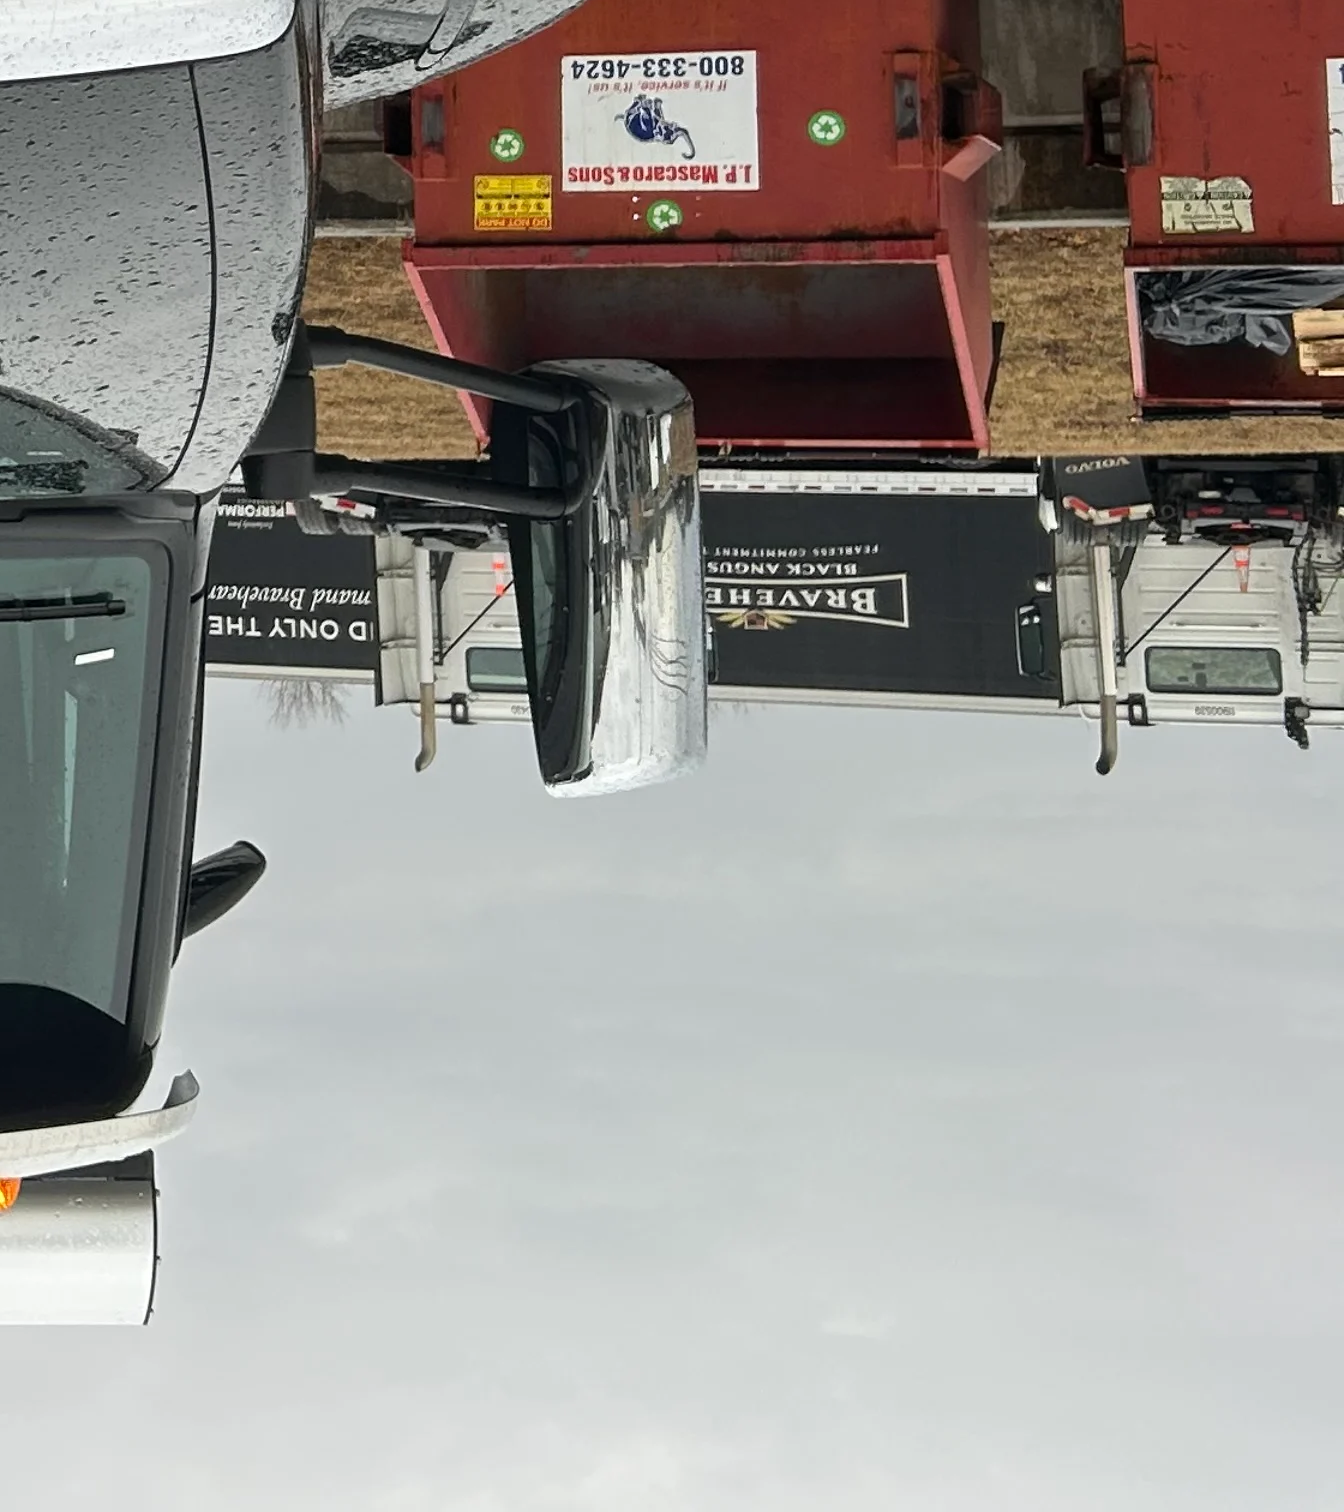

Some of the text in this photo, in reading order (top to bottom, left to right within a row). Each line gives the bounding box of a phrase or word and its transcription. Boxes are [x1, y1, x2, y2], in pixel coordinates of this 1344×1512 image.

[571, 56, 744, 79] 800-333-4624
[568, 166, 615, 185] Sons
[632, 165, 718, 184] Mascaro
[722, 165, 752, 184] J.P.
[1064, 456, 1130, 475] VOLVO
[714, 546, 807, 558] COMMITMENT
[811, 543, 879, 556] FEARLESS
[706, 561, 858, 576] BLACK ANGUS
[207, 584, 371, 612] mand Bravehear
[208, 615, 261, 637] THE
[269, 617, 339, 641] ONLY
